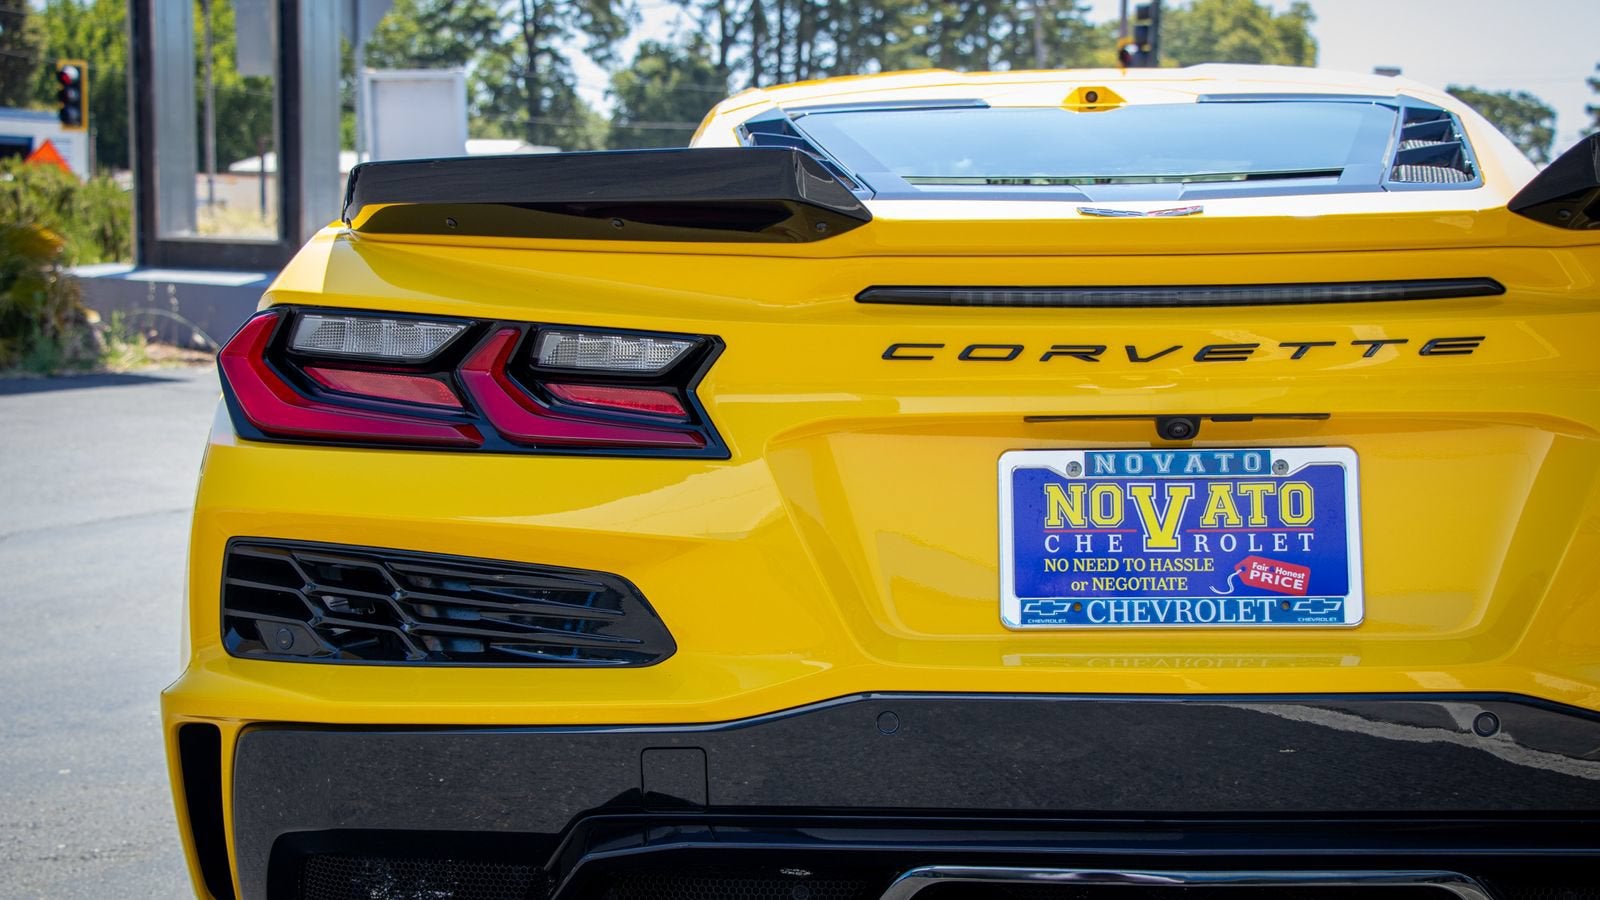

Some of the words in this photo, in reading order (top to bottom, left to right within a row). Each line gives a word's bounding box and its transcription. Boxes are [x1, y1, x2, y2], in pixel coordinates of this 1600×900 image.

[881, 336, 1486, 362] CORVETTE
[1095, 454, 1262, 474] NOVATO
[1044, 482, 1315, 552] NOVATO
[1044, 558, 1069, 572] NO
[1073, 558, 1119, 572] NEED
[1123, 558, 1146, 571] TO
[1150, 558, 1214, 572] HASSLE
[1252, 561, 1270, 572] Fair
[1275, 566, 1305, 579] Honest
[1071, 580, 1088, 591] or
[1092, 577, 1188, 591] NEGOTIATE
[1249, 569, 1304, 590] PRICE
[1086, 600, 1277, 623] CHEVROLET
